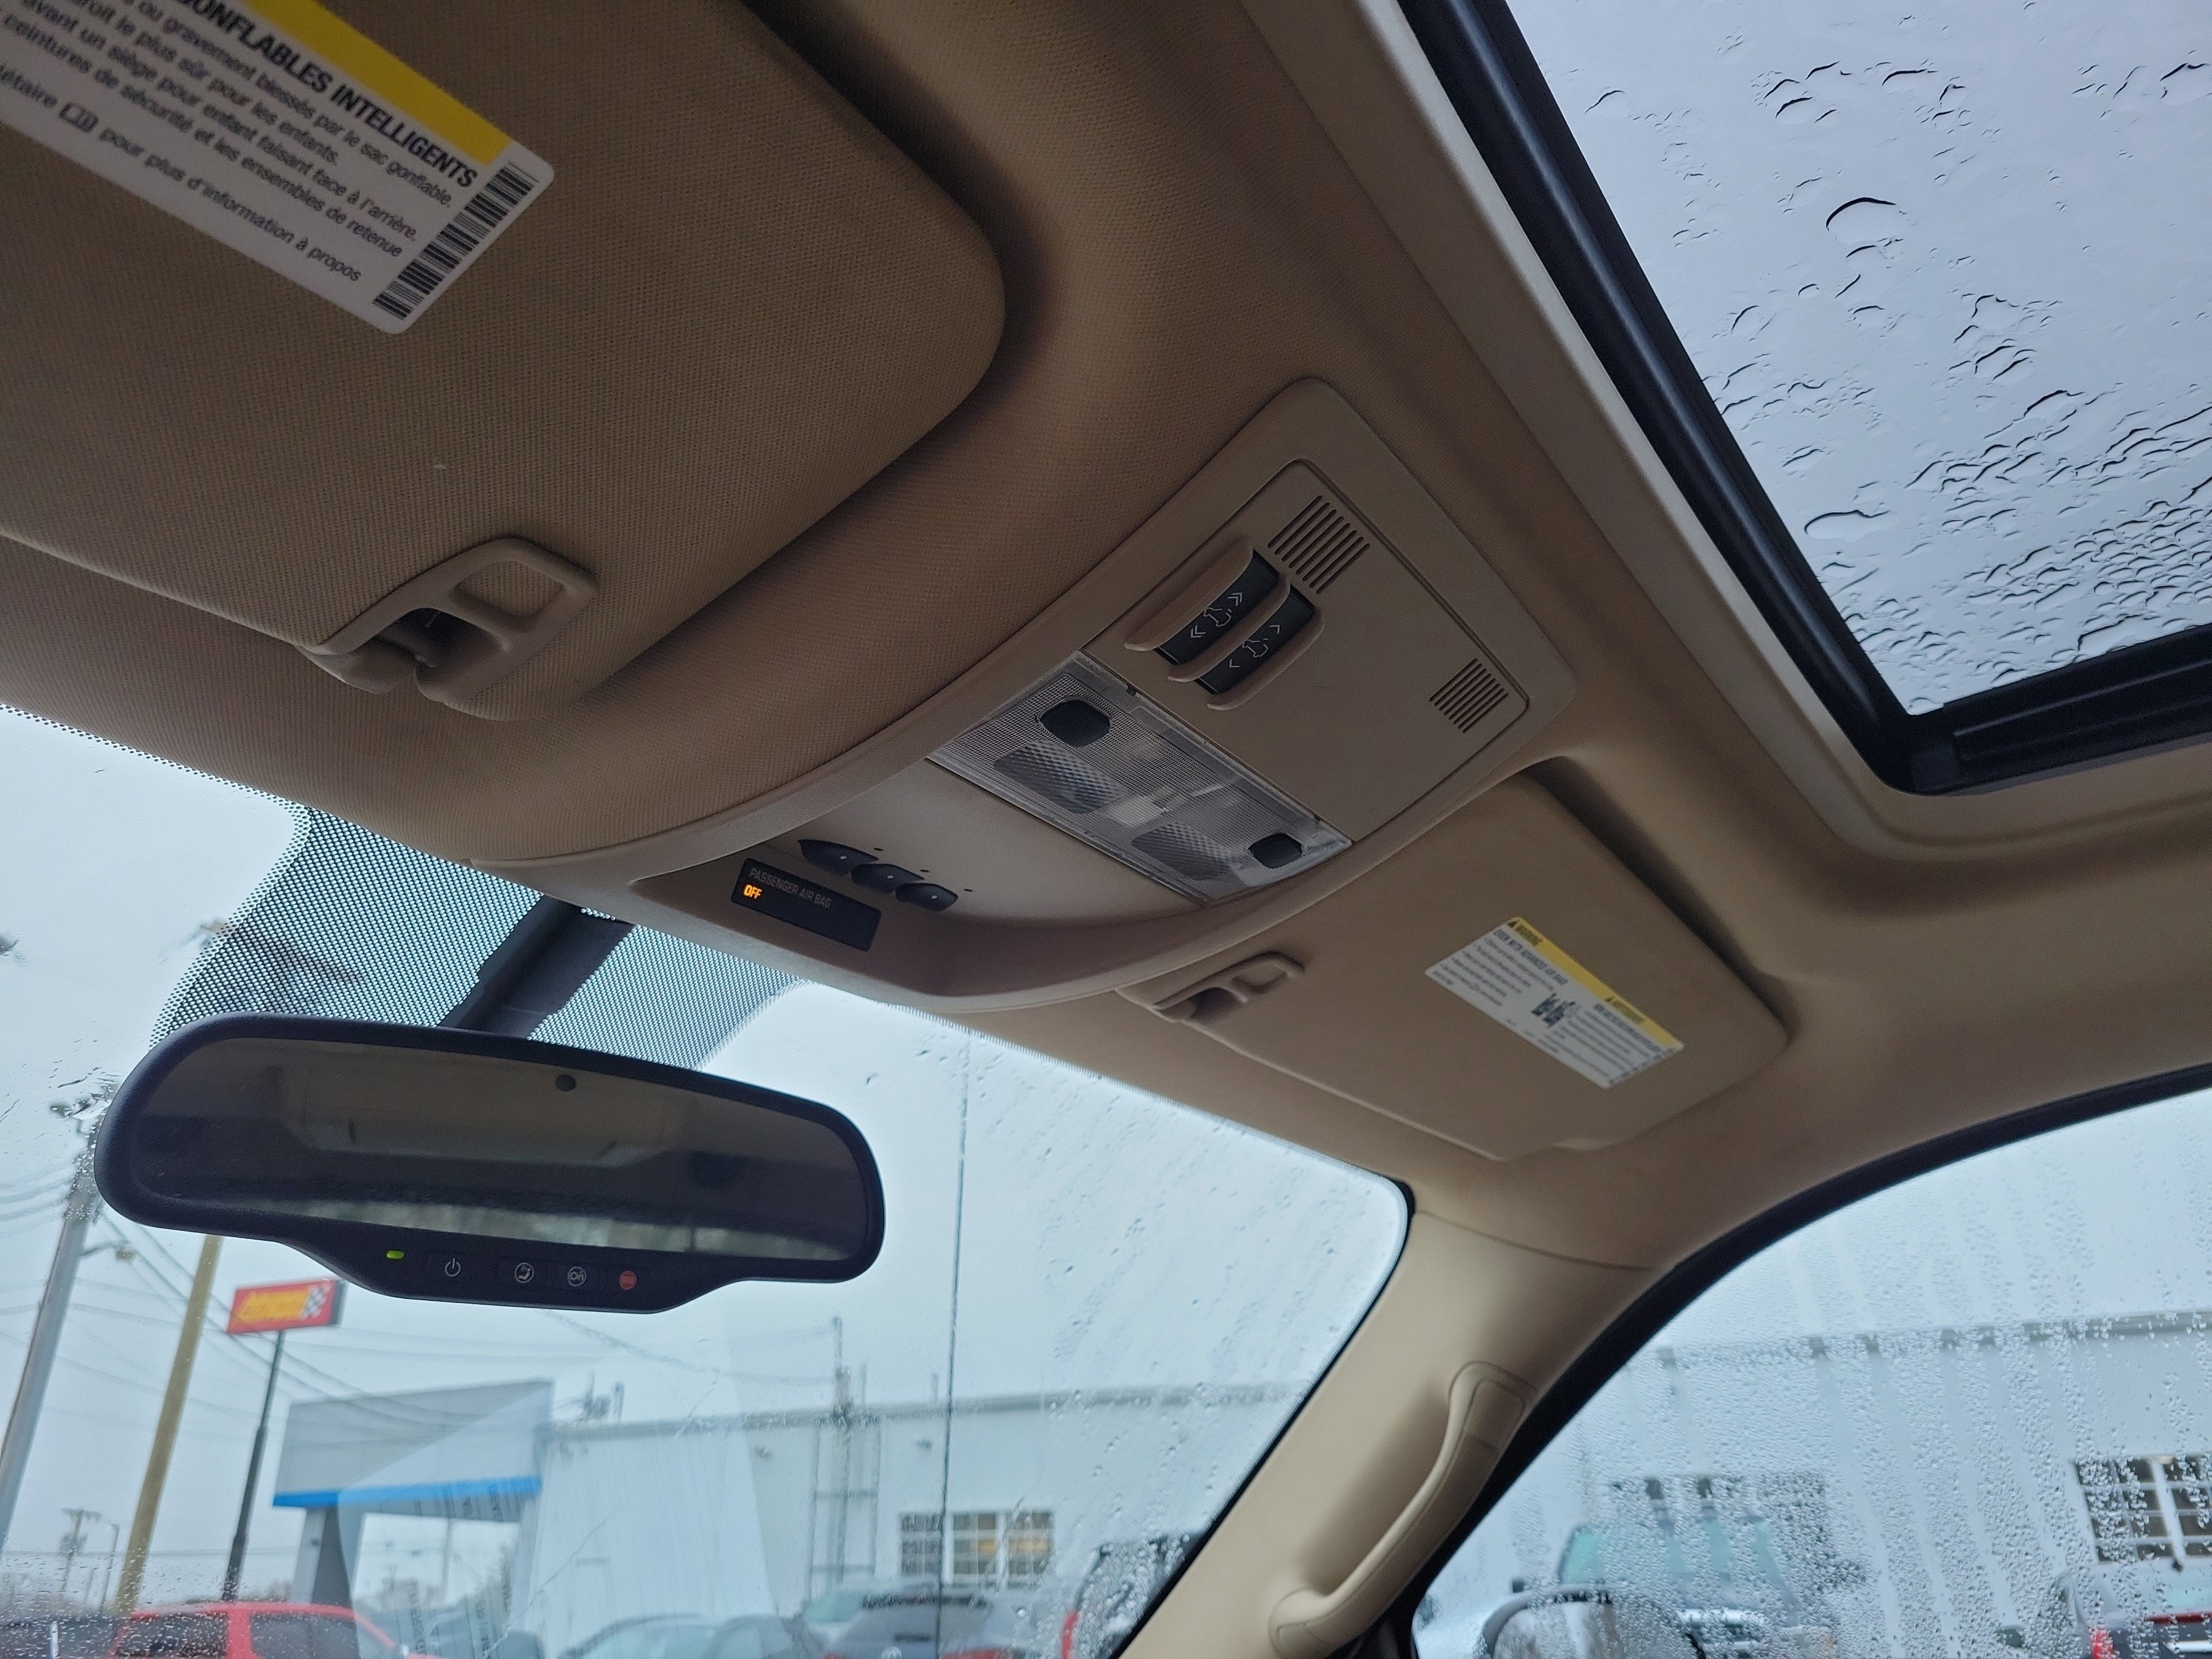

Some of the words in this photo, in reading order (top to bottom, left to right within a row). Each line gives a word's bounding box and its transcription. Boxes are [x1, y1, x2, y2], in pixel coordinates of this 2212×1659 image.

[138, 1, 163, 21] ou
[313, 115, 345, 136] par
[343, 130, 360, 147] le
[360, 143, 388, 164] sac
[386, 161, 452, 205] gonflable.
[157, 77, 201, 106] pour
[203, 105, 257, 141] enfant
[312, 168, 347, 196] face
[346, 190, 360, 205] à
[207, 78, 251, 106] pour
[251, 101, 278, 125] les
[278, 121, 337, 163] enfants.
[331, 86, 476, 187] INTELLIGENTS
[93, 69, 119, 89] de
[194, 129, 215, 144] et
[325, 207, 347, 224] de
[347, 221, 402, 257] retenue
[99, 128, 144, 156] pour
[187, 178, 294, 242] d'information
[295, 238, 308, 251] à
[307, 247, 361, 281] propos
[743, 884, 763, 899] OFF
[749, 867, 799, 895] PASSENGER
[799, 888, 814, 902] AIR
[814, 894, 832, 909] BAG
